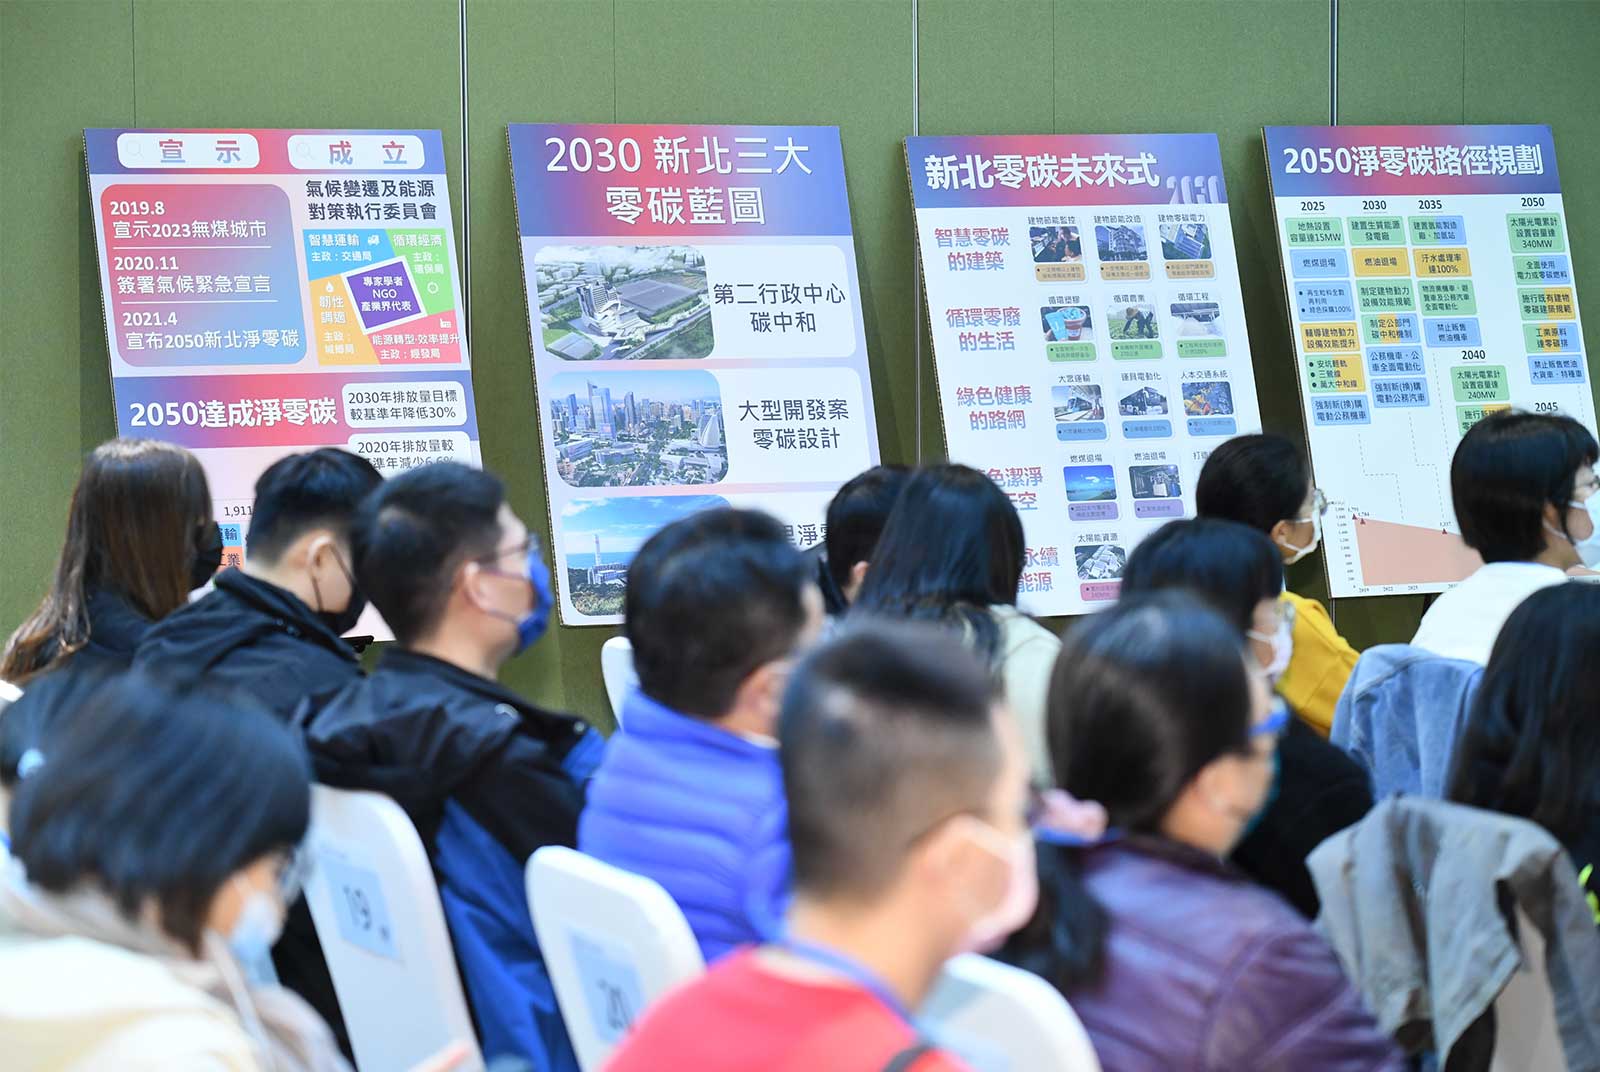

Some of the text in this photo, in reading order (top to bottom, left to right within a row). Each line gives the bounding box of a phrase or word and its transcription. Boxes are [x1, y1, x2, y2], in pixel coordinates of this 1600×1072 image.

[544, 136, 812, 176] 2030 新北三大
[1283, 144, 1544, 177] 2050淨零碳路徑規劃
[924, 152, 1161, 190] 新北零碳未來式
[306, 179, 436, 198] 氣候變遷及能源
[110, 200, 165, 216] 2019.8
[604, 186, 766, 226] 零碳藍圖
[1300, 201, 1326, 211] 2025
[1362, 200, 1387, 210] 2030
[1418, 200, 1442, 210] 2035
[1520, 197, 1545, 207] 2050
[308, 202, 436, 221] 對策執行委員會
[112, 220, 267, 239] 宣示2023無煤城市
[1298, 222, 1331, 231] 地熱設置
[1351, 220, 1400, 230] 建置生質能源
[1510, 217, 1558, 227] 太陽光電累計
[308, 234, 360, 246] 智慧運輸
[393, 234, 442, 247] 循環經濟
[934, 227, 1011, 248] 智慧零碳
[1290, 233, 1341, 243] 容量達15MW
[1365, 232, 1390, 241] 發電廠
[1516, 228, 1556, 238] 設置容量達
[1522, 240, 1552, 248] 340MW
[114, 256, 179, 272] 2020.11
[948, 252, 1005, 272] 的建築
[1429, 264, 1459, 274] 達100%
[116, 274, 272, 294] 簽署氣候緊急宣言
[364, 276, 404, 286] 專家學者
[372, 290, 397, 299] NGO
[714, 283, 846, 306] 第二行政中心
[361, 301, 412, 312] 產業界代表
[122, 311, 178, 327] 2021.4
[750, 311, 817, 334] 碳中和
[946, 306, 1022, 328] 循環零廢
[126, 328, 300, 350] 宣布2050新北淨零碳
[958, 332, 1016, 352] 的生活
[1306, 339, 1356, 348] 設備效能提升
[1462, 350, 1486, 360] 2040
[1457, 370, 1500, 379] 太陽光電累計
[1462, 380, 1498, 390] 設置容量達
[348, 390, 458, 404] 2030年排放量目標
[956, 385, 1032, 407] 綠色健康
[1468, 390, 1496, 400] 240MW
[130, 398, 338, 428] 2050達成淨零碳
[350, 406, 457, 421] 較基準年降低30%
[738, 399, 850, 422] 大型開發案
[1534, 402, 1558, 412] 2045
[970, 410, 1026, 431] 的路網
[753, 427, 841, 450] 零碳設計
[358, 439, 454, 454] 2020年排放量較
